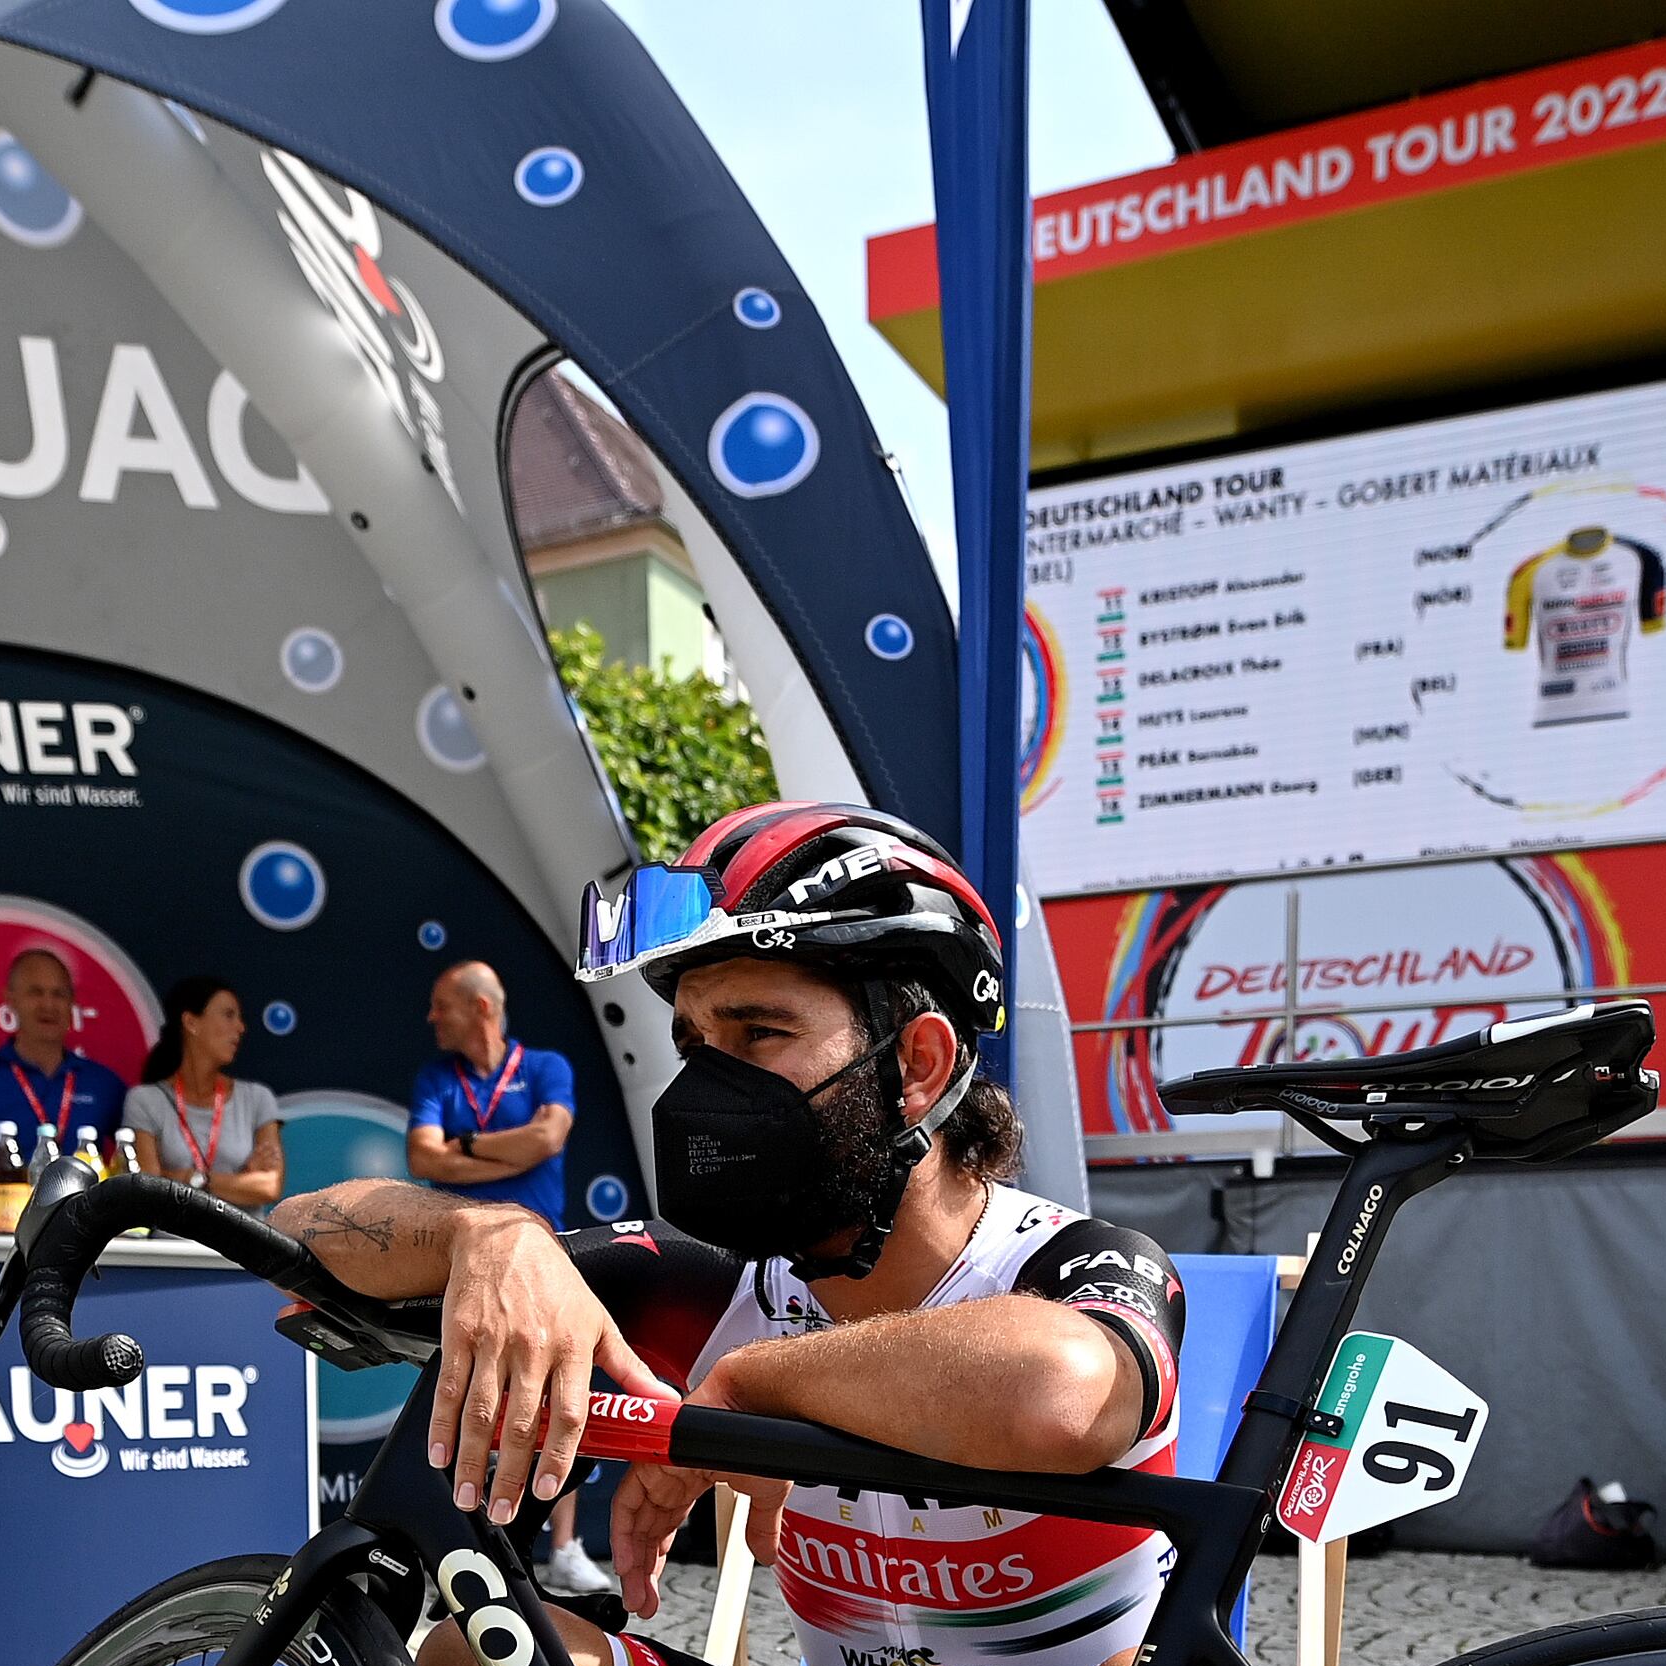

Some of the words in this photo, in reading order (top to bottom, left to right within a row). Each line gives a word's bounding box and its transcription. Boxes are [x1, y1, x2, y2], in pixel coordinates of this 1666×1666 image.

[1033, 147, 1354, 261] EUTSCHLAND
[1366, 110, 1517, 180] TOUR
[1026, 510, 1185, 558] NTERMARCHÉ
[1215, 491, 1307, 529] WANTY
[1336, 468, 1439, 511] GOBERT
[1213, 466, 1285, 498] TOUR
[1, 783, 32, 806] Wir
[36, 783, 71, 806] sind
[75, 785, 143, 808] Wasser.
[1194, 944, 1536, 1001] DEUTSCHLAND
[1278, 1087, 1340, 1115] prologo
[1336, 1183, 1384, 1276] COLNAGO
[585, 1390, 659, 1424] rates
[1333, 1353, 1367, 1418] ansgrohe
[120, 1446, 148, 1472] Wir
[152, 1447, 189, 1471] sind
[192, 1447, 250, 1471] Wasser.
[1362, 1400, 1480, 1492] 91
[1282, 1448, 1314, 1519] DEUTSCHLAND
[1293, 1455, 1337, 1517] TOUR
